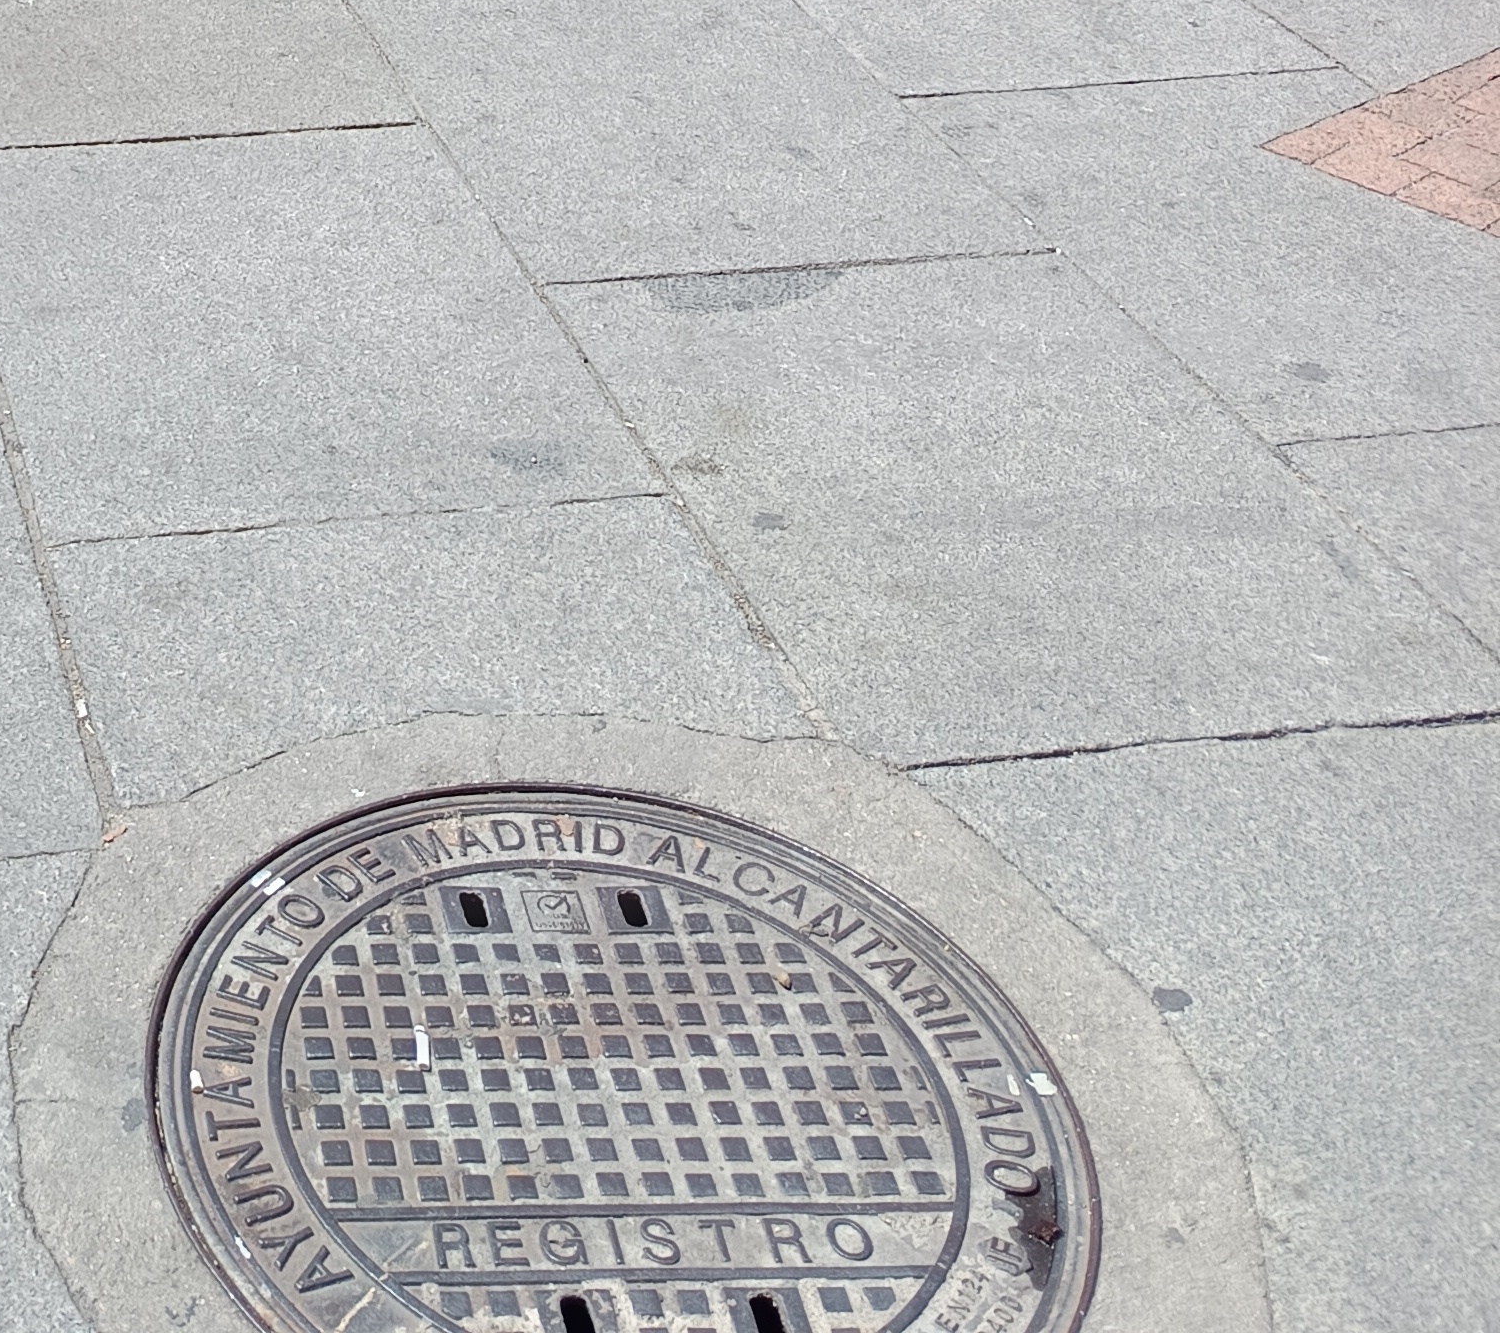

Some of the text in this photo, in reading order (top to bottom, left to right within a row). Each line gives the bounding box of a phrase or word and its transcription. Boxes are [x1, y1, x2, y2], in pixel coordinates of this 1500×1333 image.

[202, 819, 1040, 1293] AYUNTAMIENTO DE MADRID ALCANTARILLADO
[431, 1217, 874, 1269] REGISTRO
